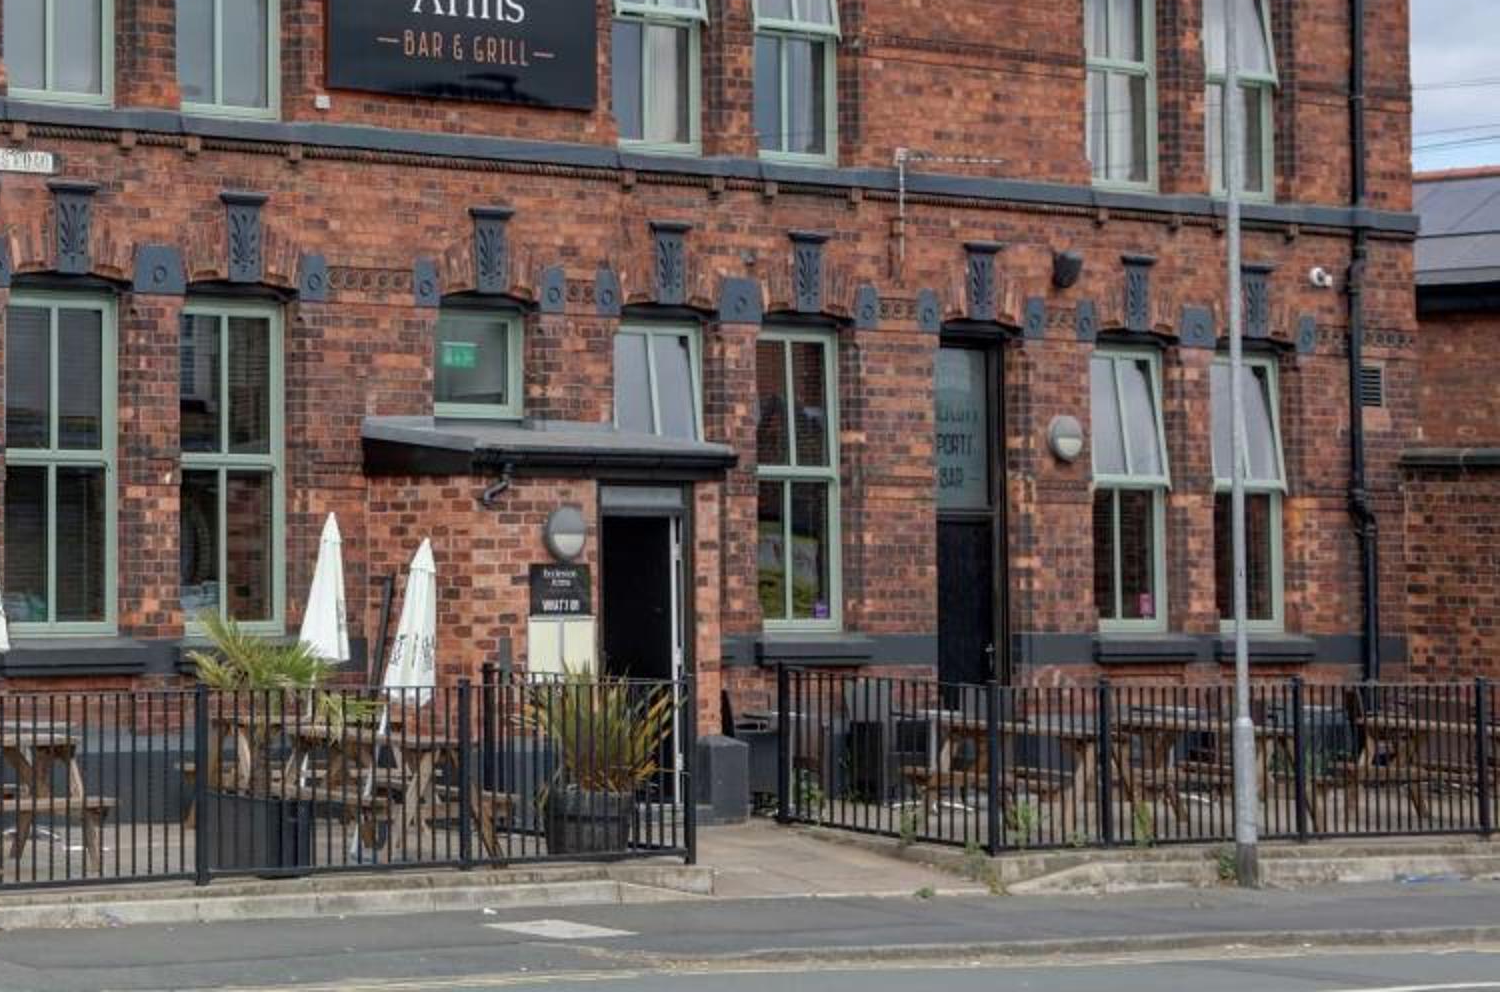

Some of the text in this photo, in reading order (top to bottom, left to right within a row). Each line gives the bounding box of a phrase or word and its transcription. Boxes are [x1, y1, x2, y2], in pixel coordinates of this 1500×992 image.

[403, 28, 531, 67] BAR & GRILL
